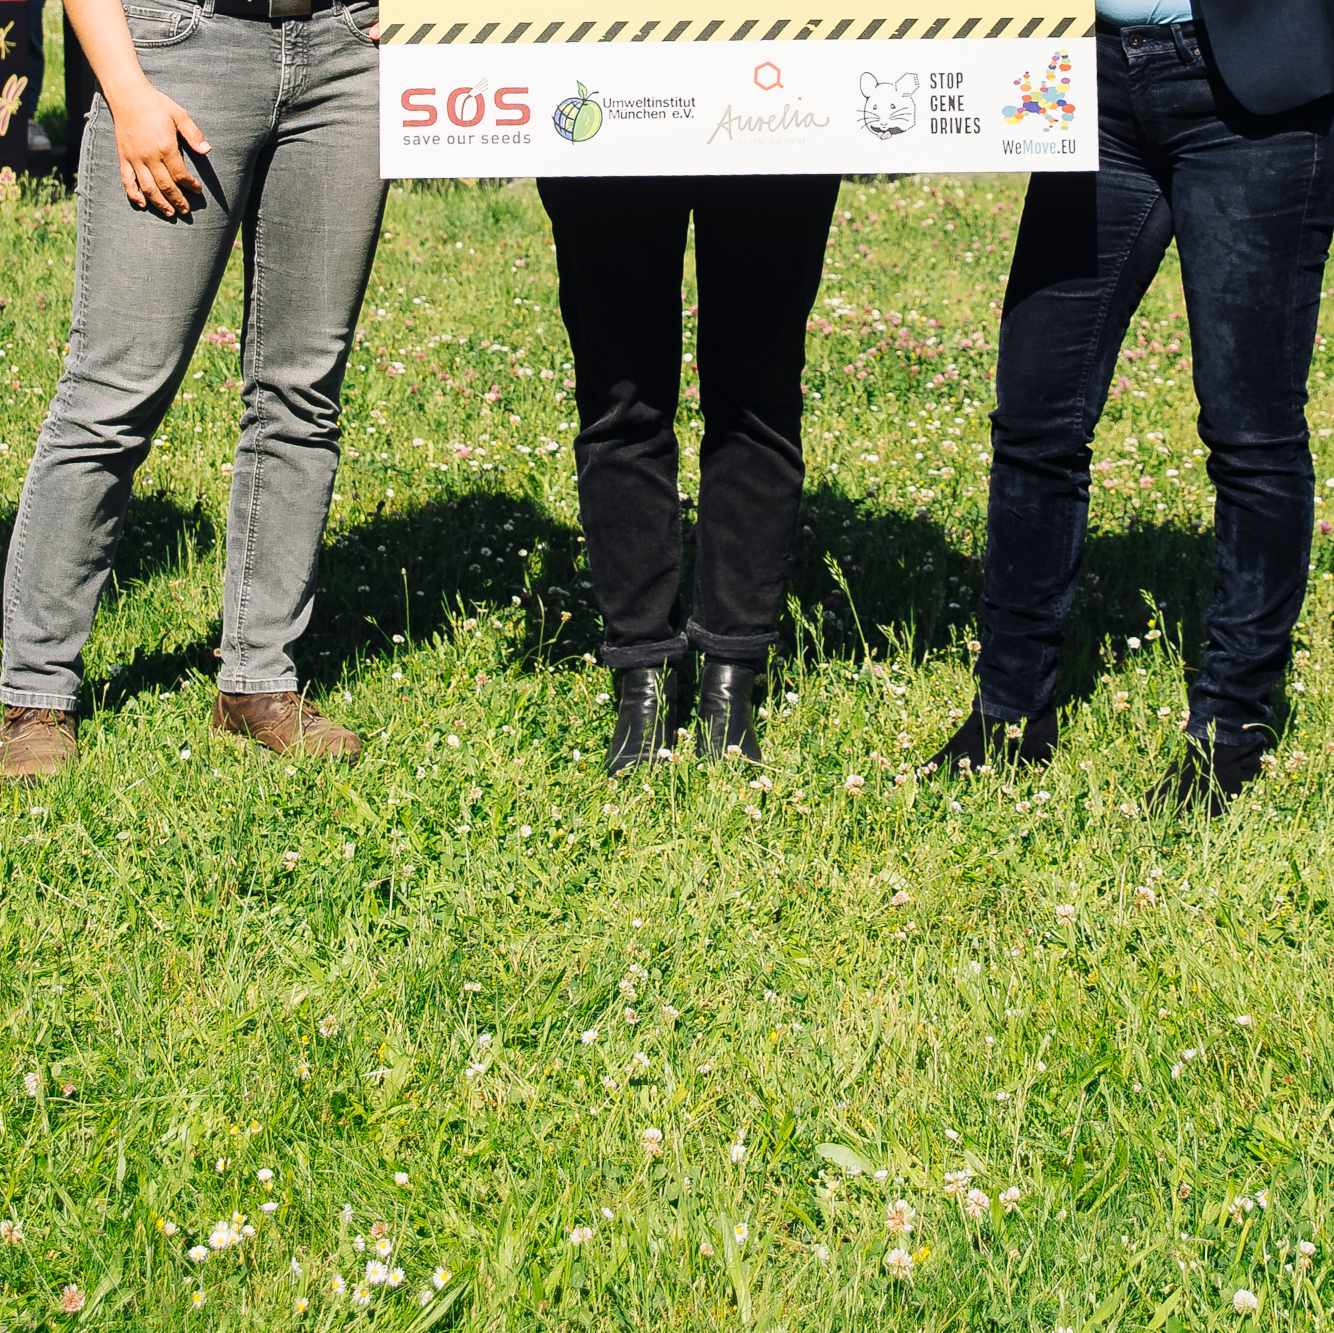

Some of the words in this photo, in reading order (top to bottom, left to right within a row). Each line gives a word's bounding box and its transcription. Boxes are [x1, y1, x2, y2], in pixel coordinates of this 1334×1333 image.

[929, 72, 964, 90] STOP
[401, 86, 531, 128] SOS
[602, 96, 696, 109] Umweltinstitut
[930, 95, 965, 113] GENE
[609, 108, 666, 120] München
[672, 108, 695, 119] e.V.
[706, 96, 831, 145] Aurelia
[930, 117, 981, 135] DRIVES
[403, 133, 441, 146] save
[447, 133, 475, 146] our
[481, 132, 531, 145] seeds
[1002, 139, 1076, 156] WeMove.EU
